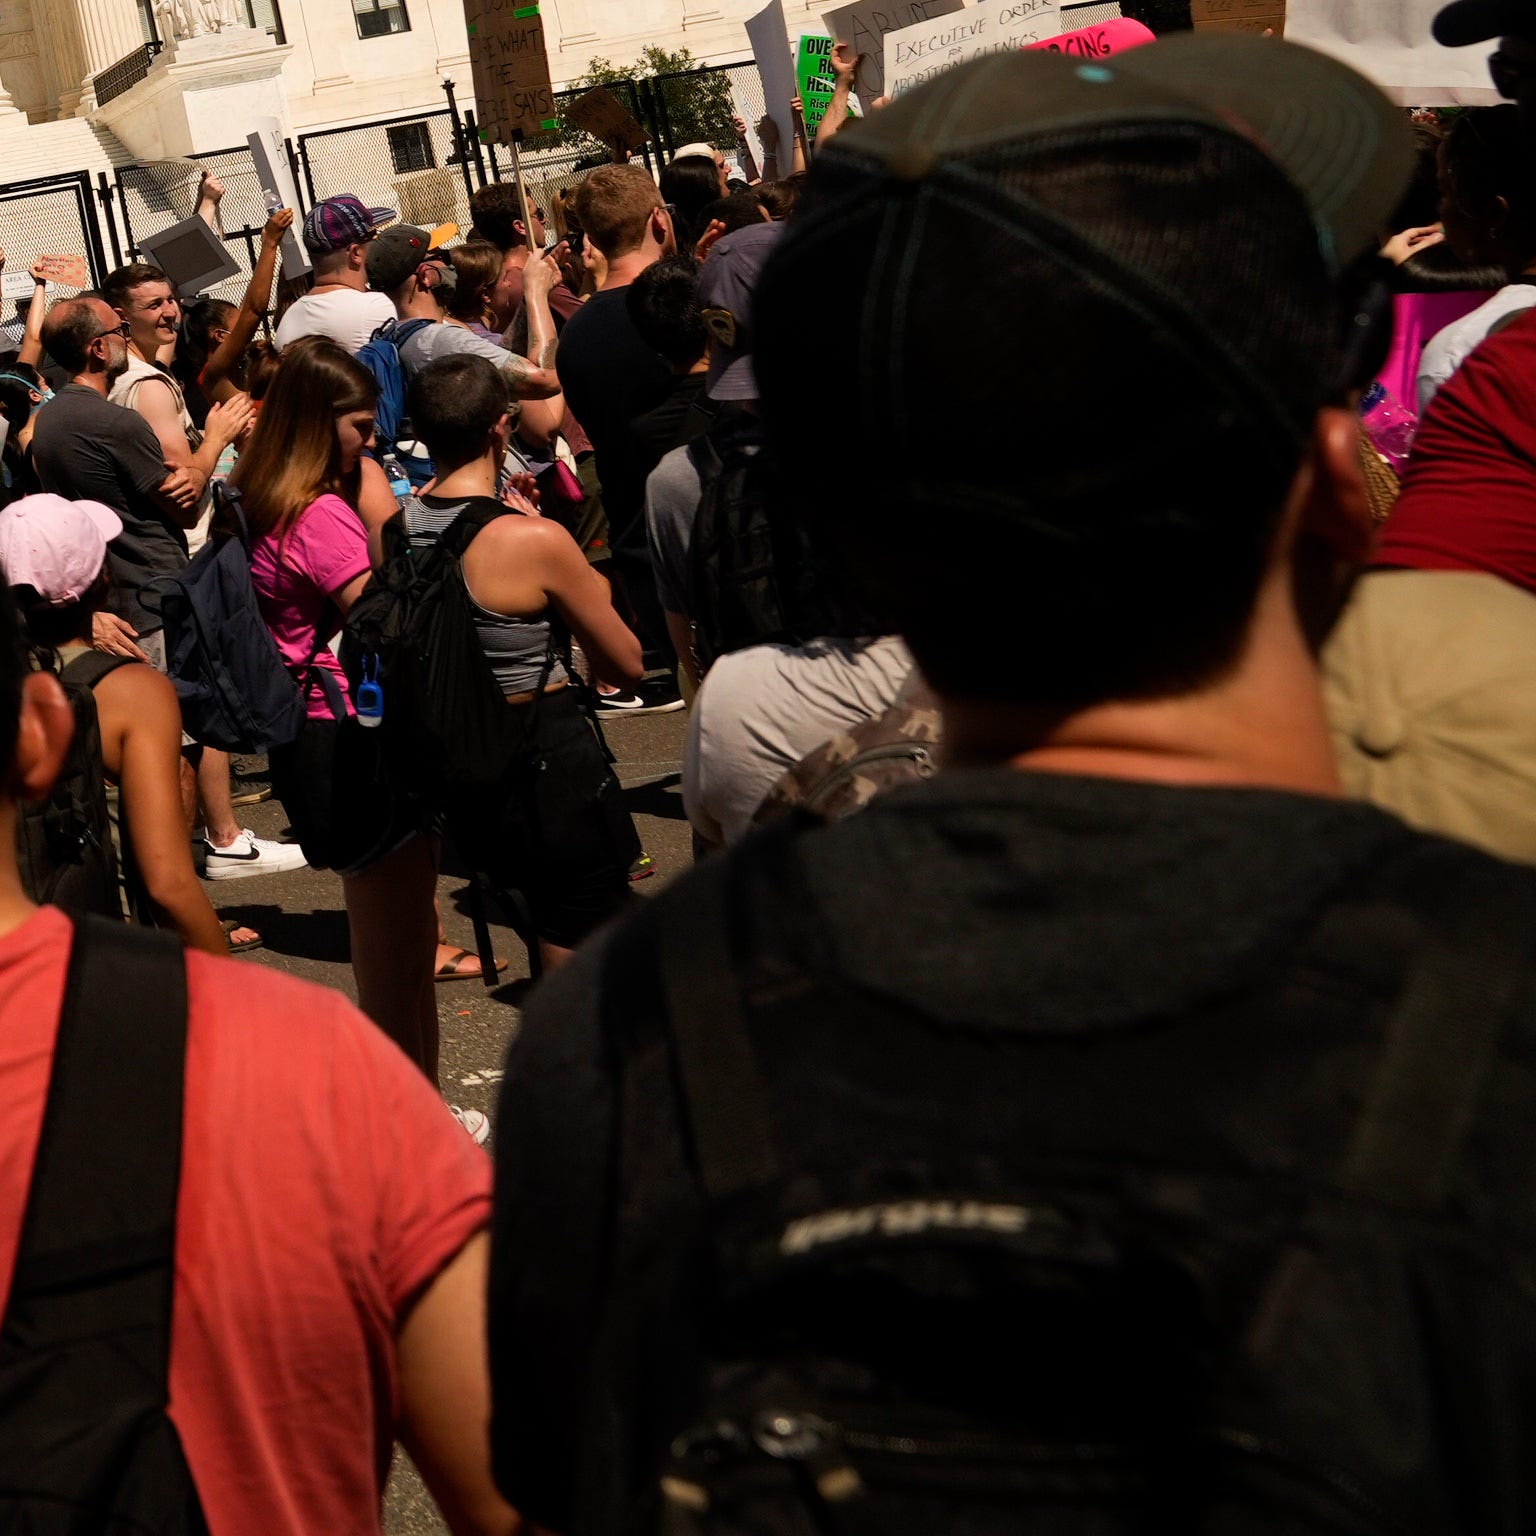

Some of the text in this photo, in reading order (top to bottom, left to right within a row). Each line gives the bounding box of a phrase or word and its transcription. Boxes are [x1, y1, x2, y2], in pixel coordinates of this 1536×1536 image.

[496, 28, 540, 55] WHAT
[806, 38, 835, 56] OVE
[895, 17, 987, 65] EXECUTIVE
[512, 89, 550, 120] SAYS
[809, 111, 822, 121] Ab
[5, 275, 23, 283] AREA
